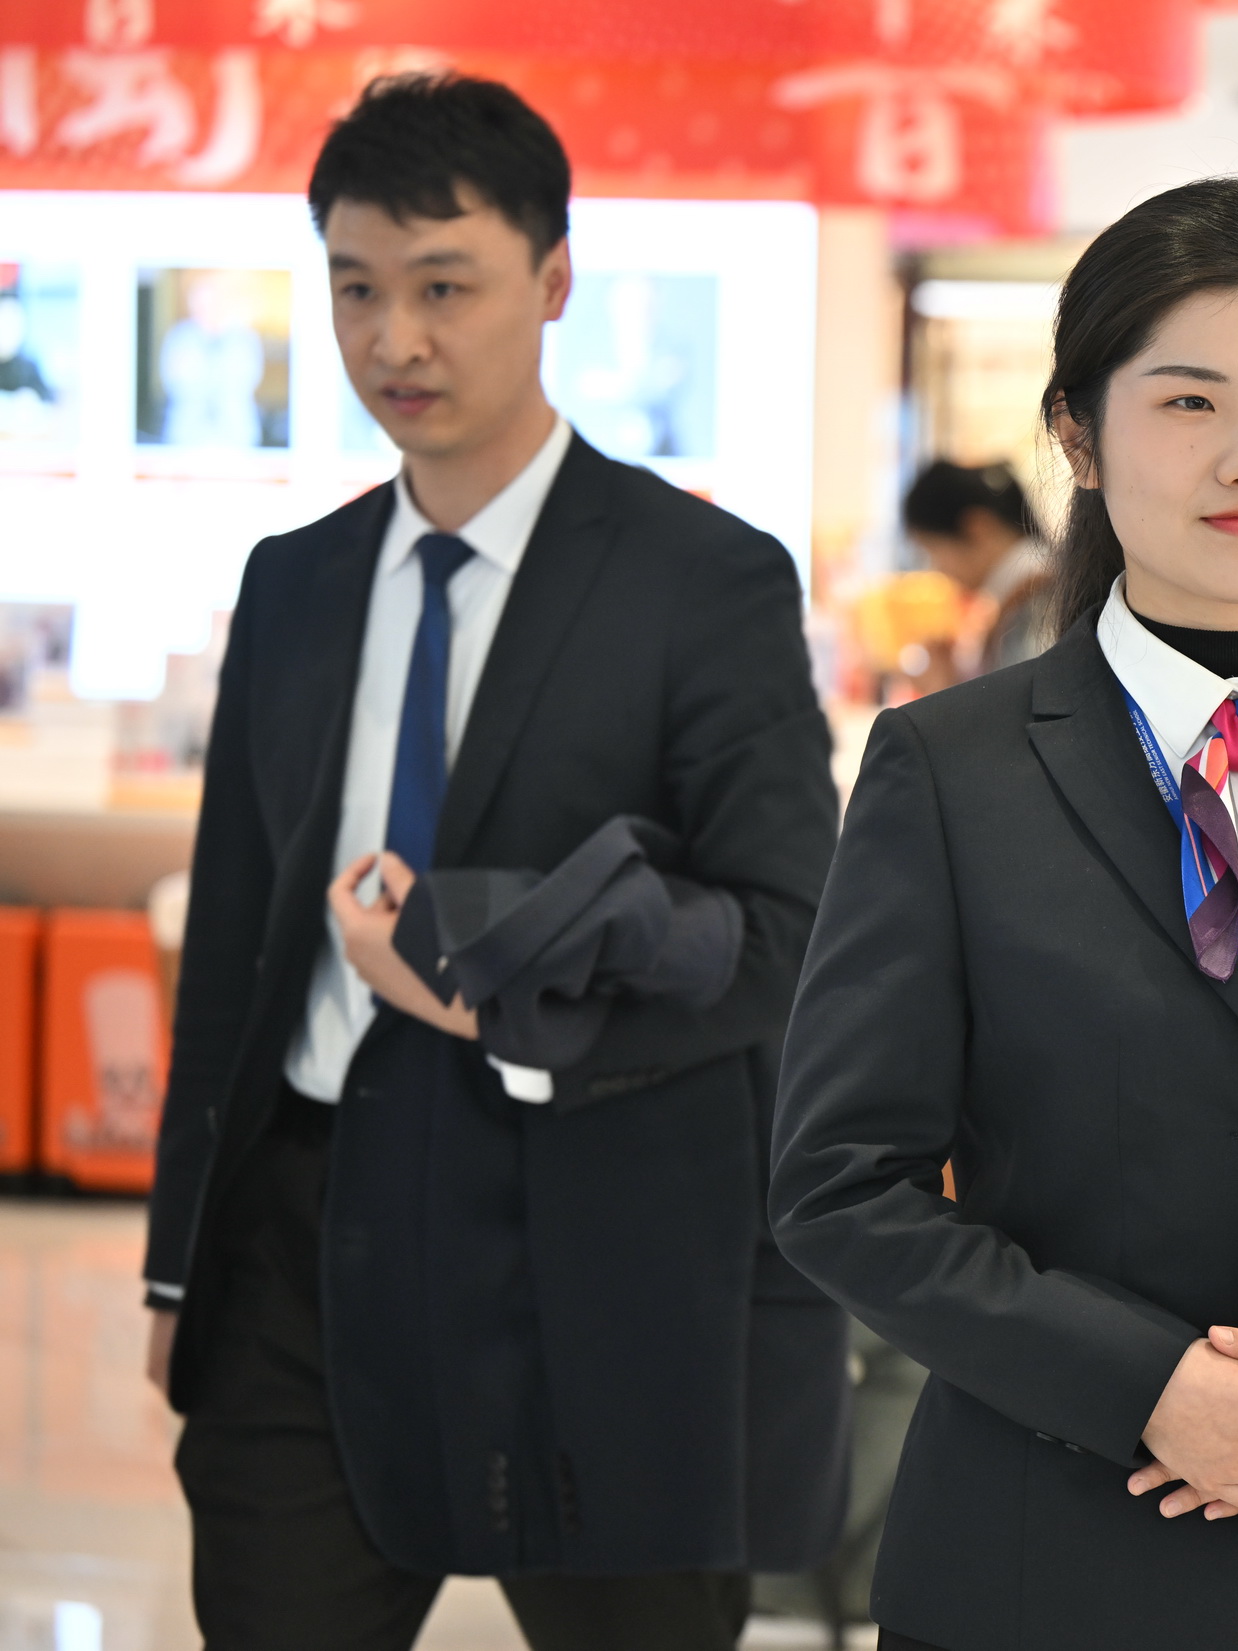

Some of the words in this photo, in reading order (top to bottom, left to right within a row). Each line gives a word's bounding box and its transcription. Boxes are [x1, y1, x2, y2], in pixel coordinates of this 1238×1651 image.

[1133, 710, 1143, 726] SCHOOL
[1141, 726, 1153, 749] TECHNICAL
[1151, 749, 1161, 765] SENIOR
[1159, 766, 1168, 777] EAST
